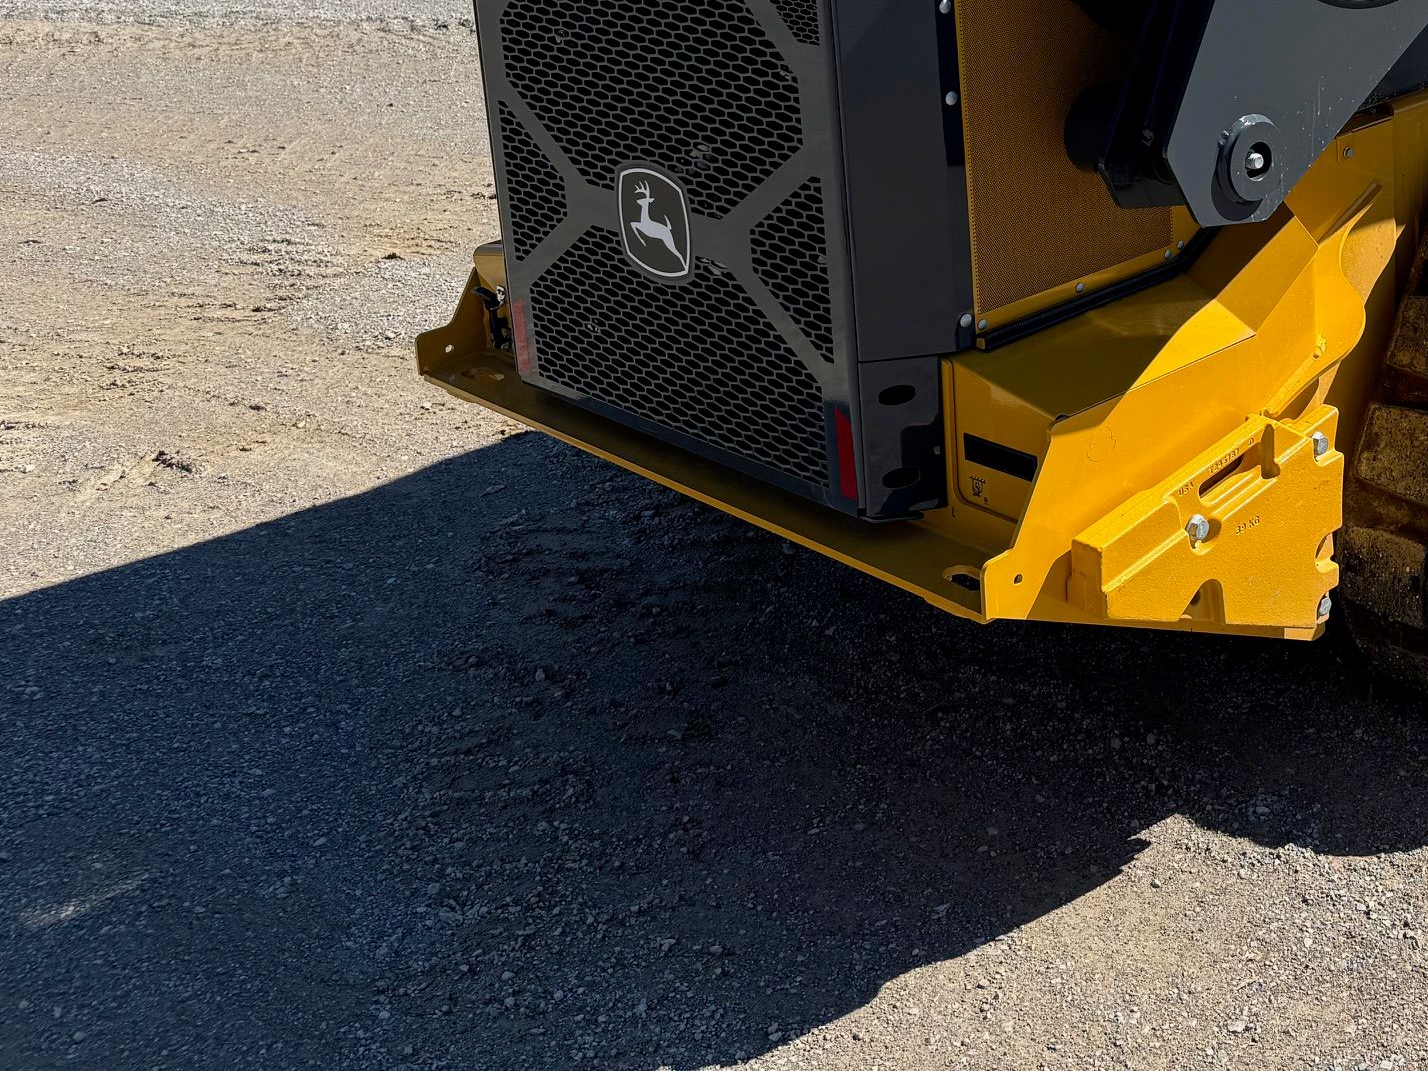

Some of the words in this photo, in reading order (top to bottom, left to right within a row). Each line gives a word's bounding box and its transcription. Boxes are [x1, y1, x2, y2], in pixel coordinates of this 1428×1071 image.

[1178, 481, 1195, 496] USA
[1235, 522, 1247, 535] 39
[1248, 515, 1261, 528] KG
